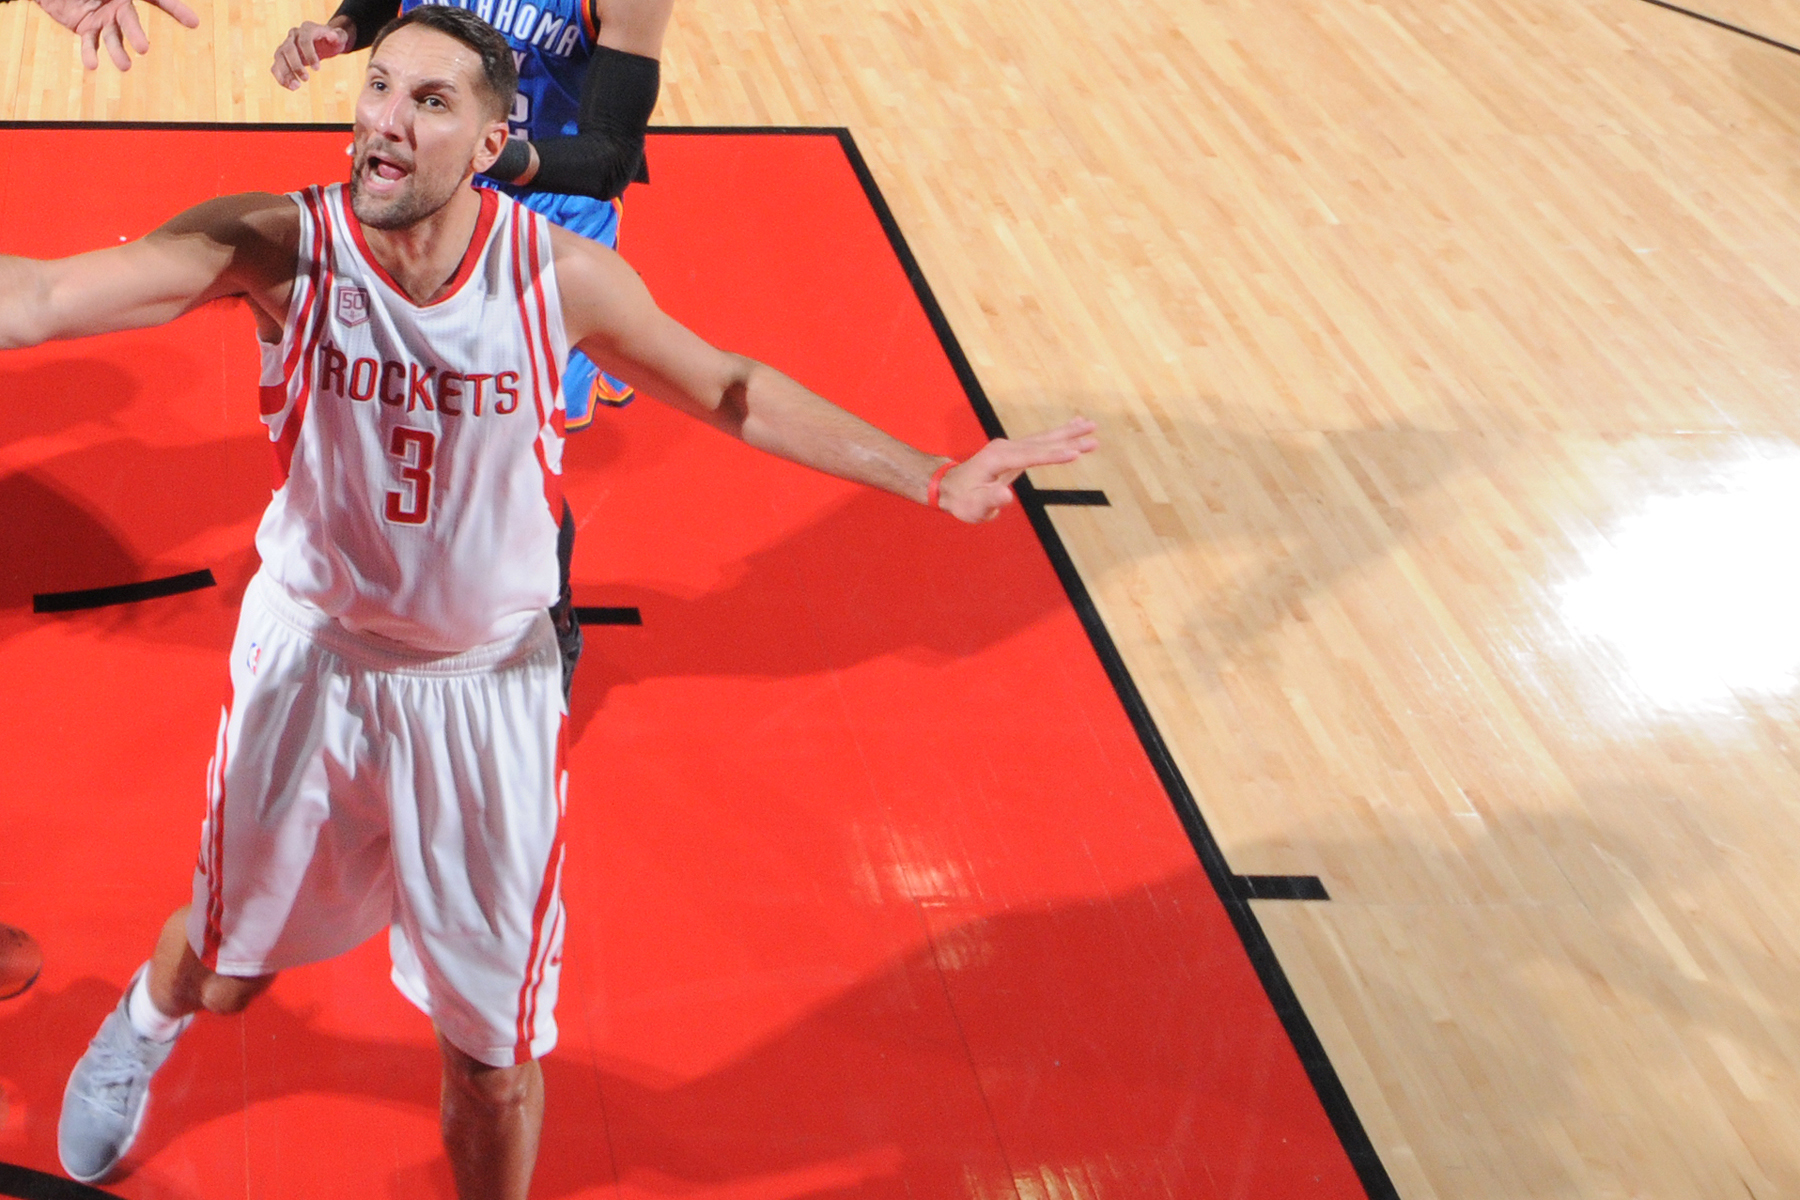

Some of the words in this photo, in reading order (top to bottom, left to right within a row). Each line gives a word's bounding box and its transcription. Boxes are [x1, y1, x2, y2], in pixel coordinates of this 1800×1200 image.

[342, 291, 366, 310] 50
[320, 339, 520, 417] ROCKETS
[383, 424, 437, 528] 3
